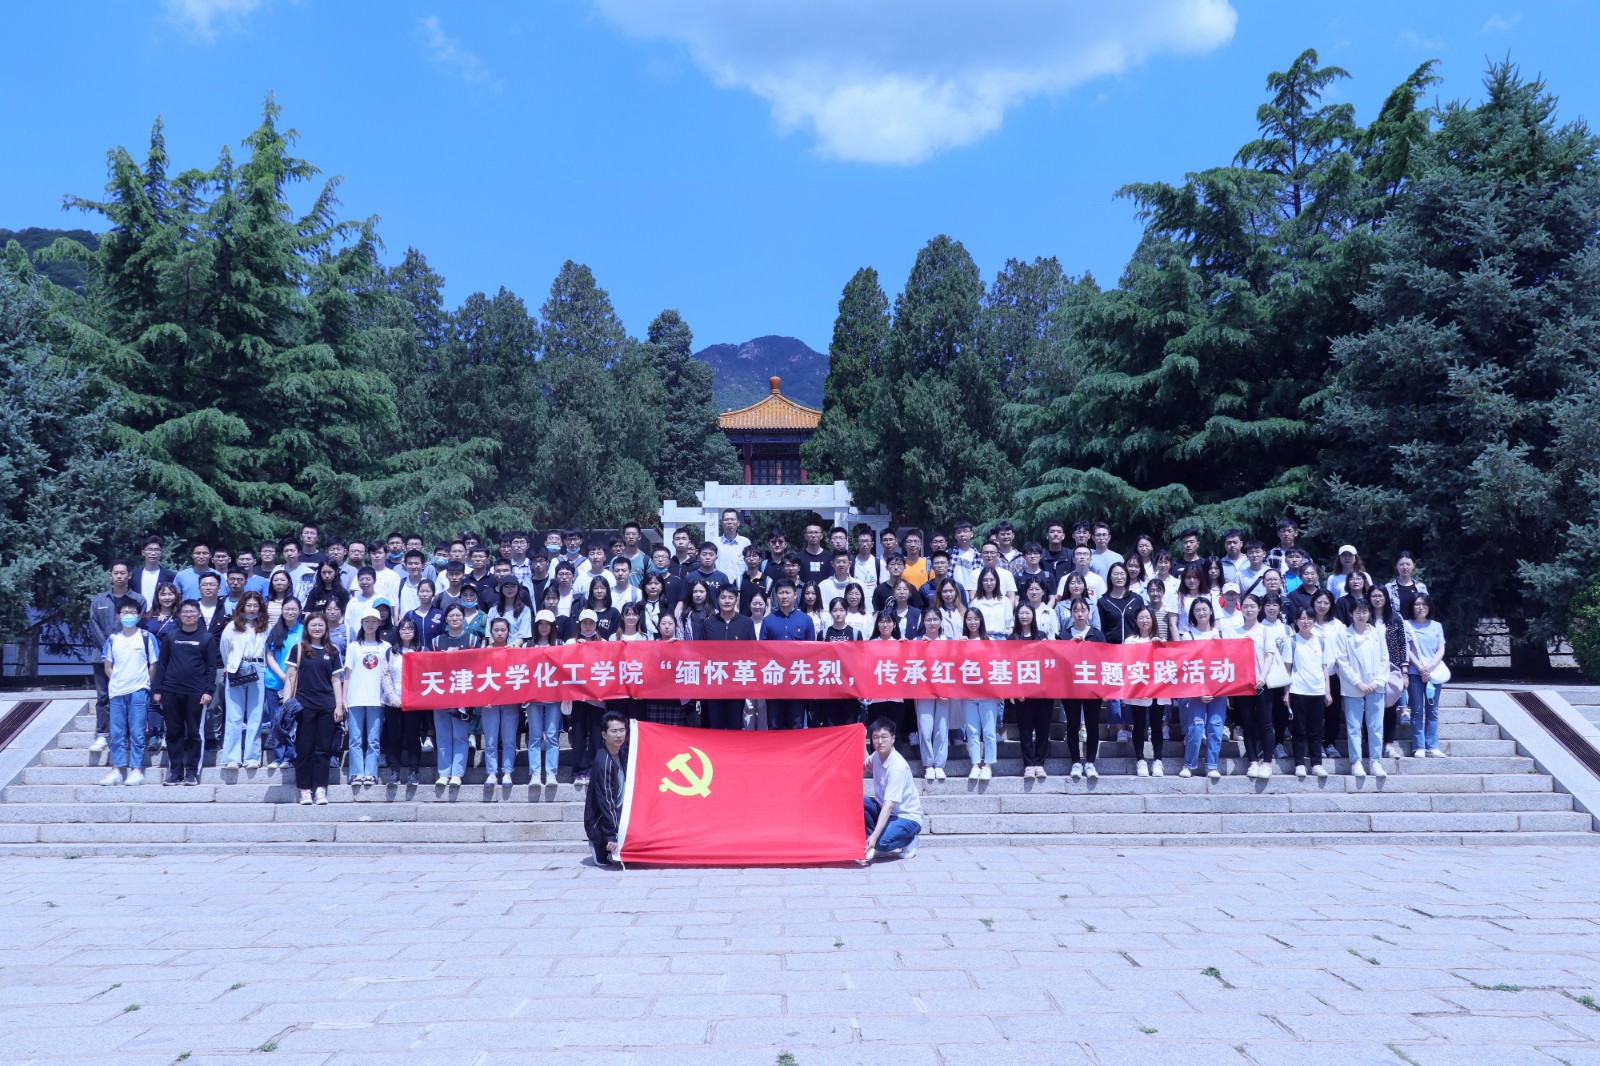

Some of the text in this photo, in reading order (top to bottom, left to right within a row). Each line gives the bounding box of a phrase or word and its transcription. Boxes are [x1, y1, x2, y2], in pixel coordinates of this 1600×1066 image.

[420, 659, 644, 697] 天津大学化工学院
[1073, 657, 1236, 686] 主题实践活动
